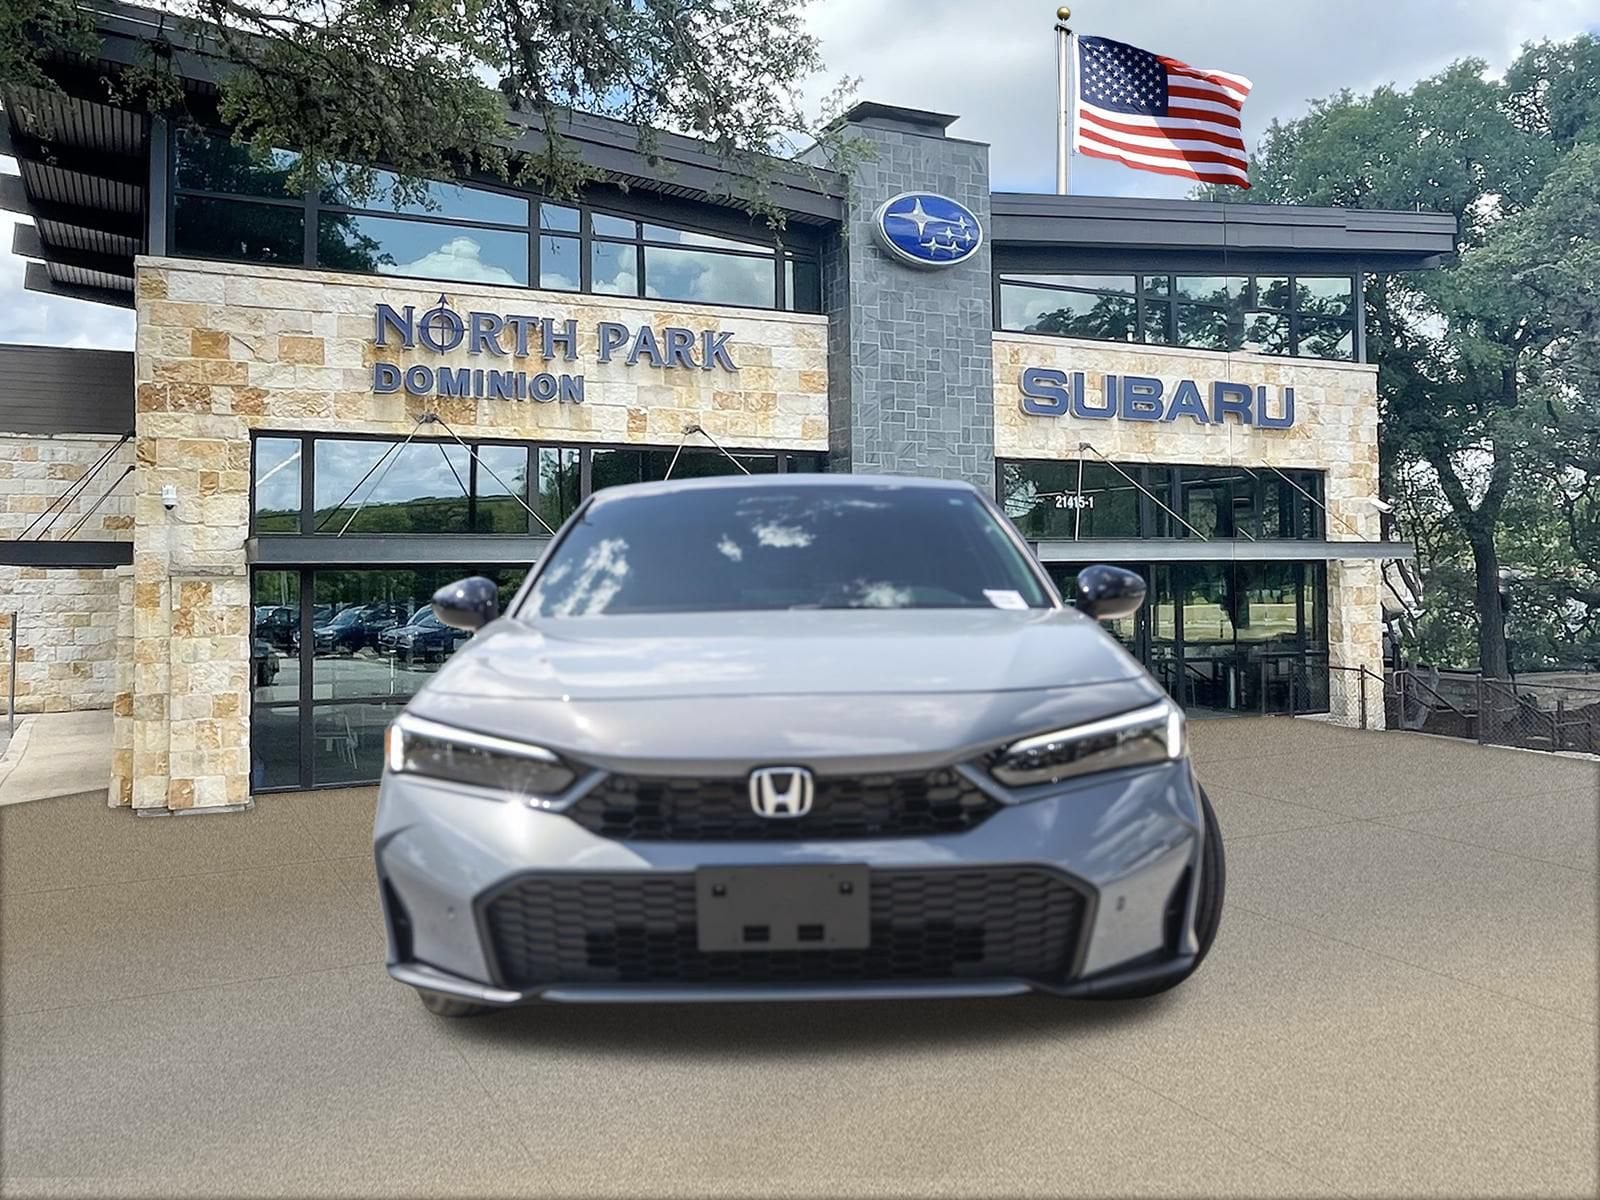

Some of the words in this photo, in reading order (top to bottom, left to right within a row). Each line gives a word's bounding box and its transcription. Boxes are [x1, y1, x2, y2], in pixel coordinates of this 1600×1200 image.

[374, 299, 579, 361] NORTH
[597, 321, 741, 372] PARK
[373, 362, 585, 404] DOMINION
[1019, 367, 1295, 430] SUBARU
